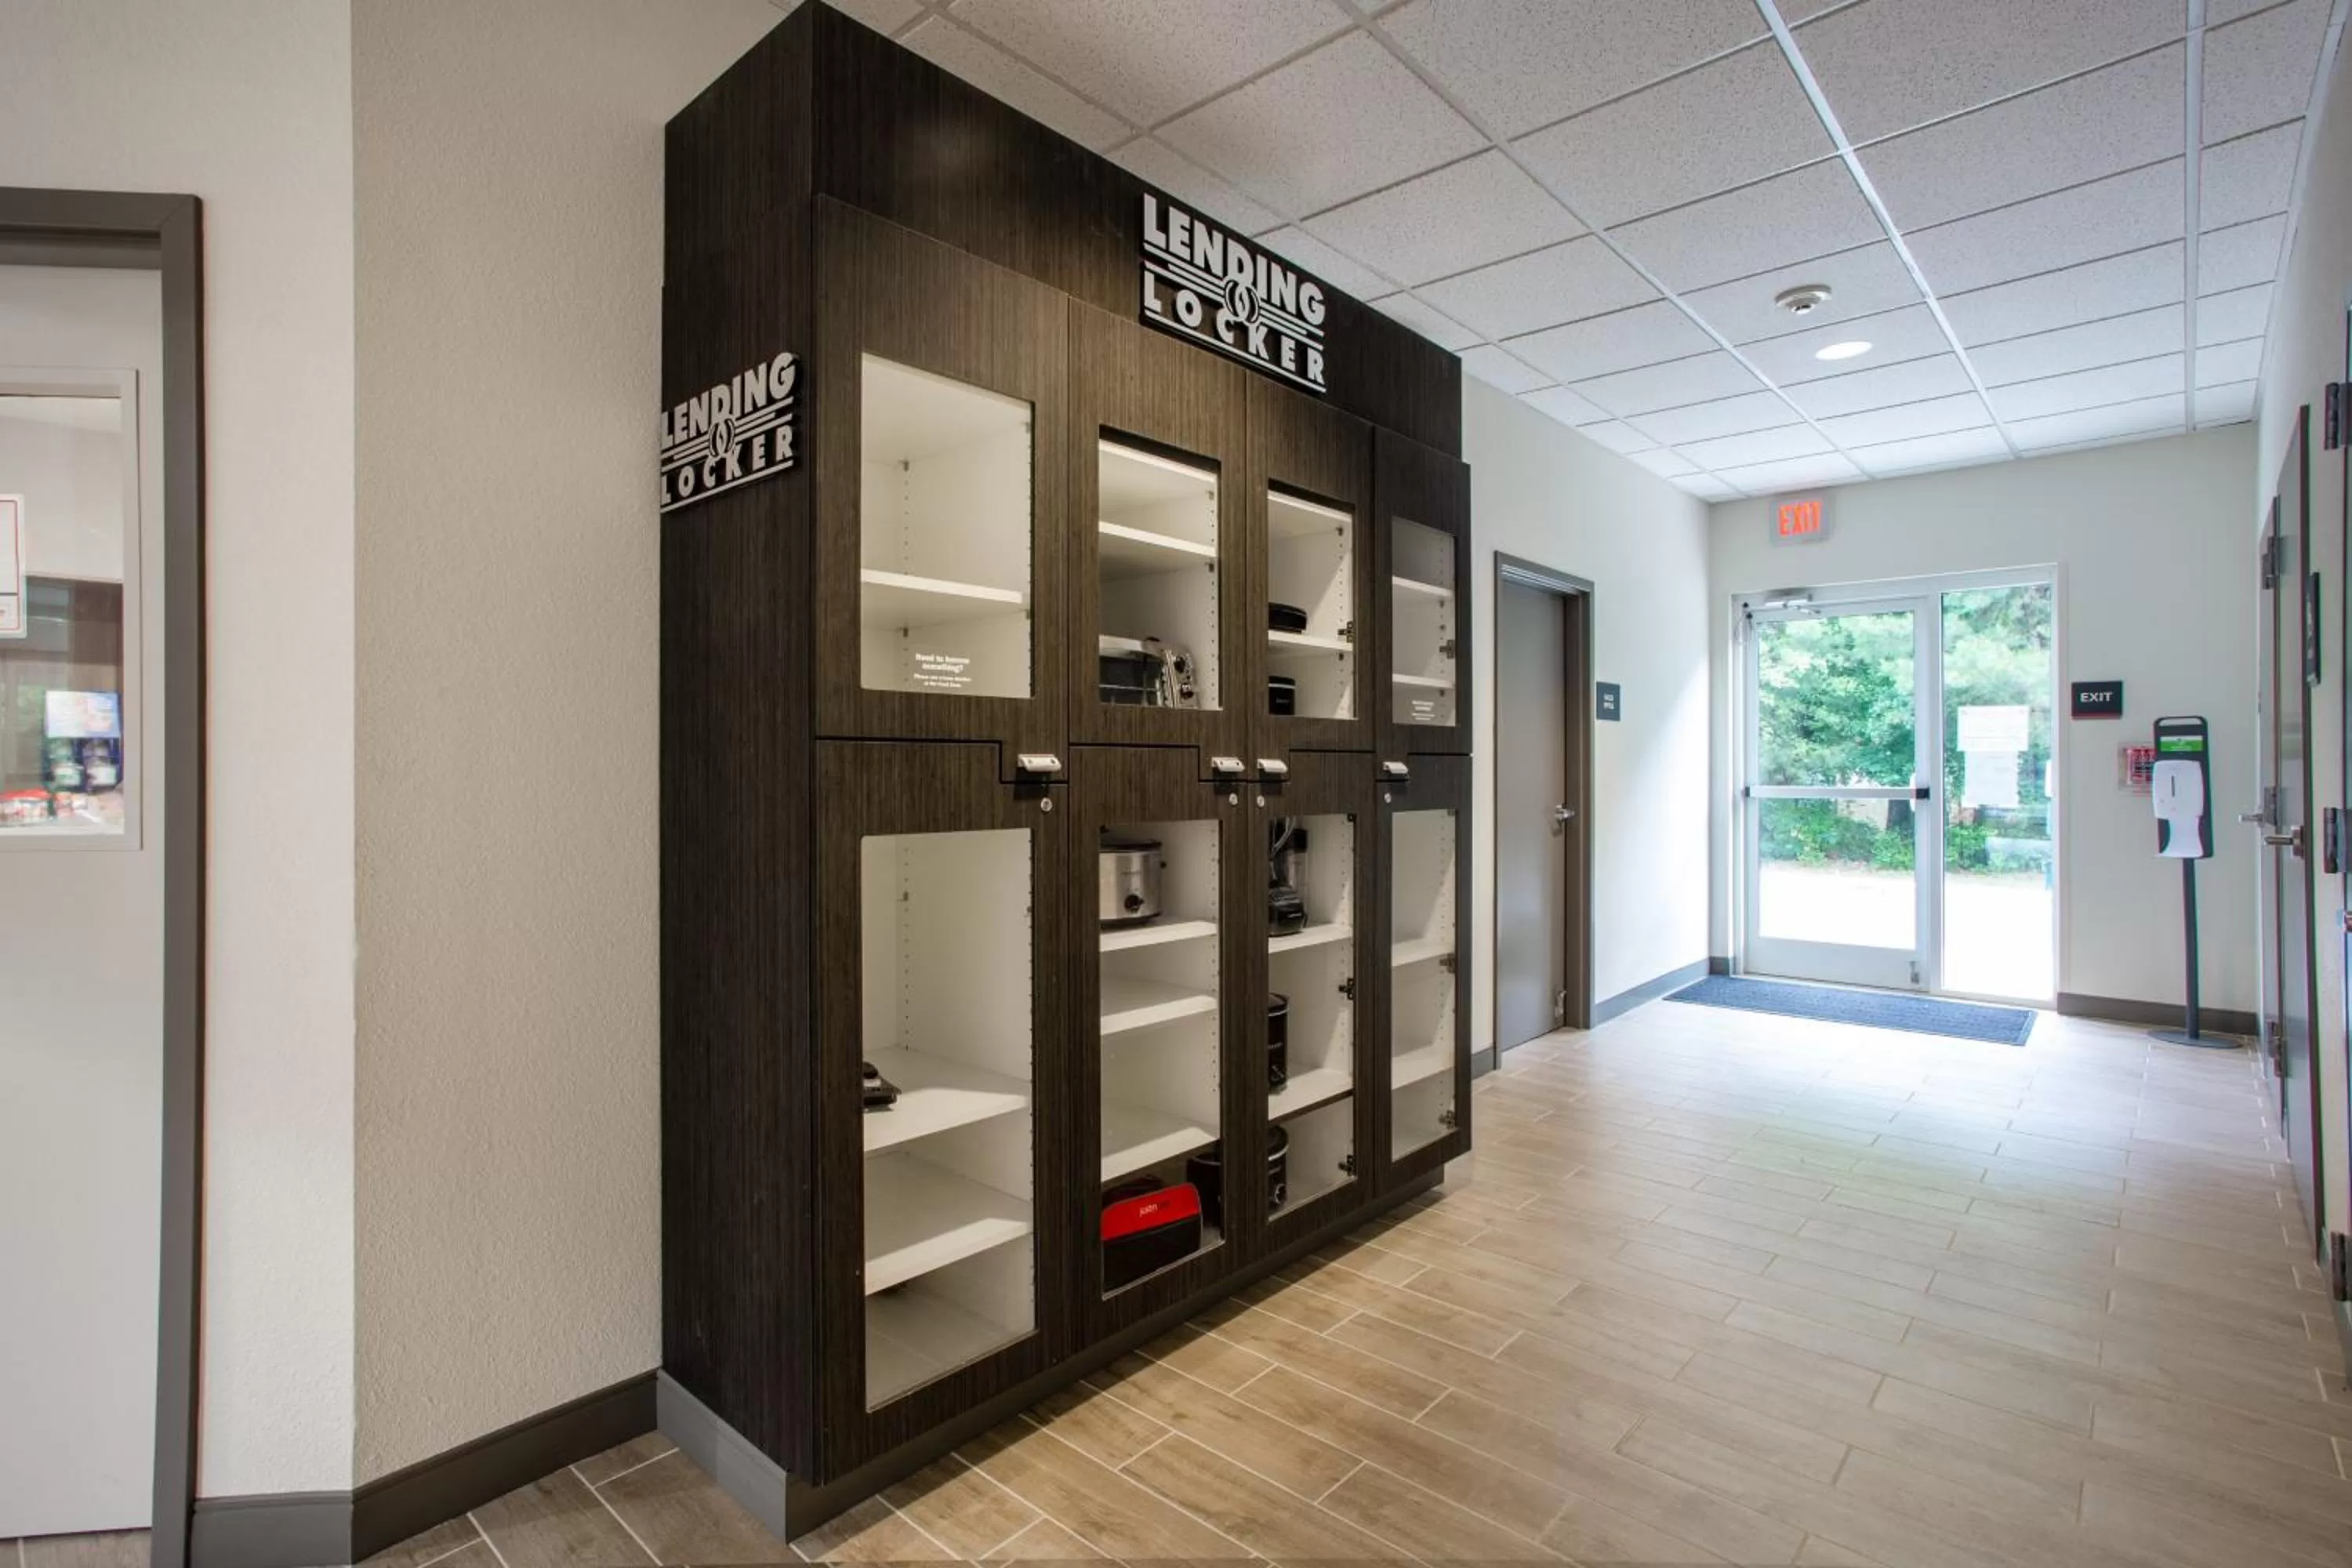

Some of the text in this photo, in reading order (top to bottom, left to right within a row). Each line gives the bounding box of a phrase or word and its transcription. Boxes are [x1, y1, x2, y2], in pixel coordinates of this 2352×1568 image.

[1144, 193, 1325, 325] LENDING
[1144, 270, 1325, 385] LOCKER
[661, 352, 796, 449] LENDING
[661, 425, 794, 505] LOCKER
[1779, 501, 1822, 535] EXIT
[2080, 691, 2114, 703] EXIT
